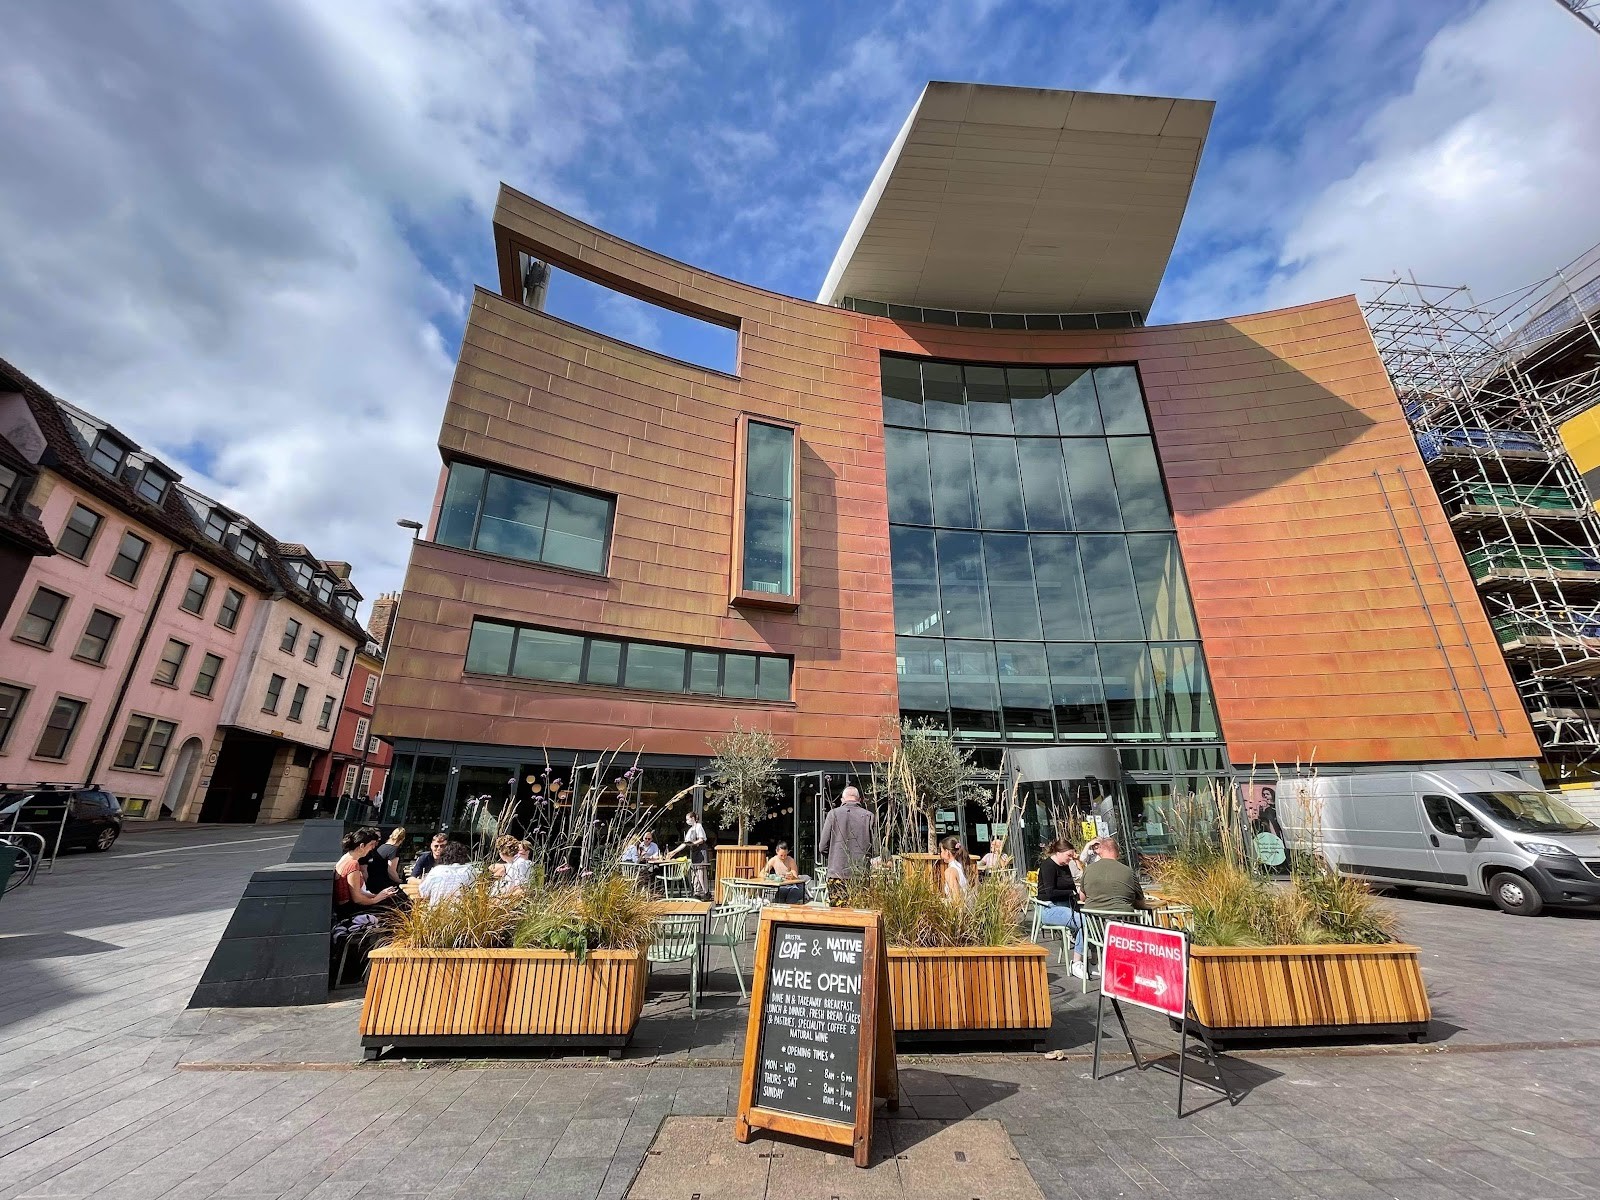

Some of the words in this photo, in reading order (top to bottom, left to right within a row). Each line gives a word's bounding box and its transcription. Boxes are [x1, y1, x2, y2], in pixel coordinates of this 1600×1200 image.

[779, 941, 807, 960] LOAF
[826, 938, 863, 952] NATIVE
[1109, 936, 1181, 960] PEDESTRIANS
[833, 951, 856, 964] VINE
[817, 973, 862, 995] OPEN!
[772, 992, 784, 1004] DINE
[785, 994, 790, 1004] IN
[798, 995, 822, 1008] TAKEAWAY
[766, 1004, 782, 1014] LUNCH
[809, 1008, 824, 1020] FRESH
[845, 1012, 860, 1024] CAKES
[798, 1018, 826, 1032] SPECIALITY
[827, 1022, 847, 1034] COFFEE
[790, 1028, 813, 1040] NATURAL
[814, 1032, 828, 1043] WINE
[786, 1045, 811, 1058] OPENING
[812, 1048, 828, 1062] TIMES
[764, 1058, 778, 1070] MON
[784, 1062, 796, 1074] WED
[764, 1072, 782, 1084] THURS
[788, 1076, 798, 1088] SAT
[762, 1086, 784, 1100] SUNDAY
